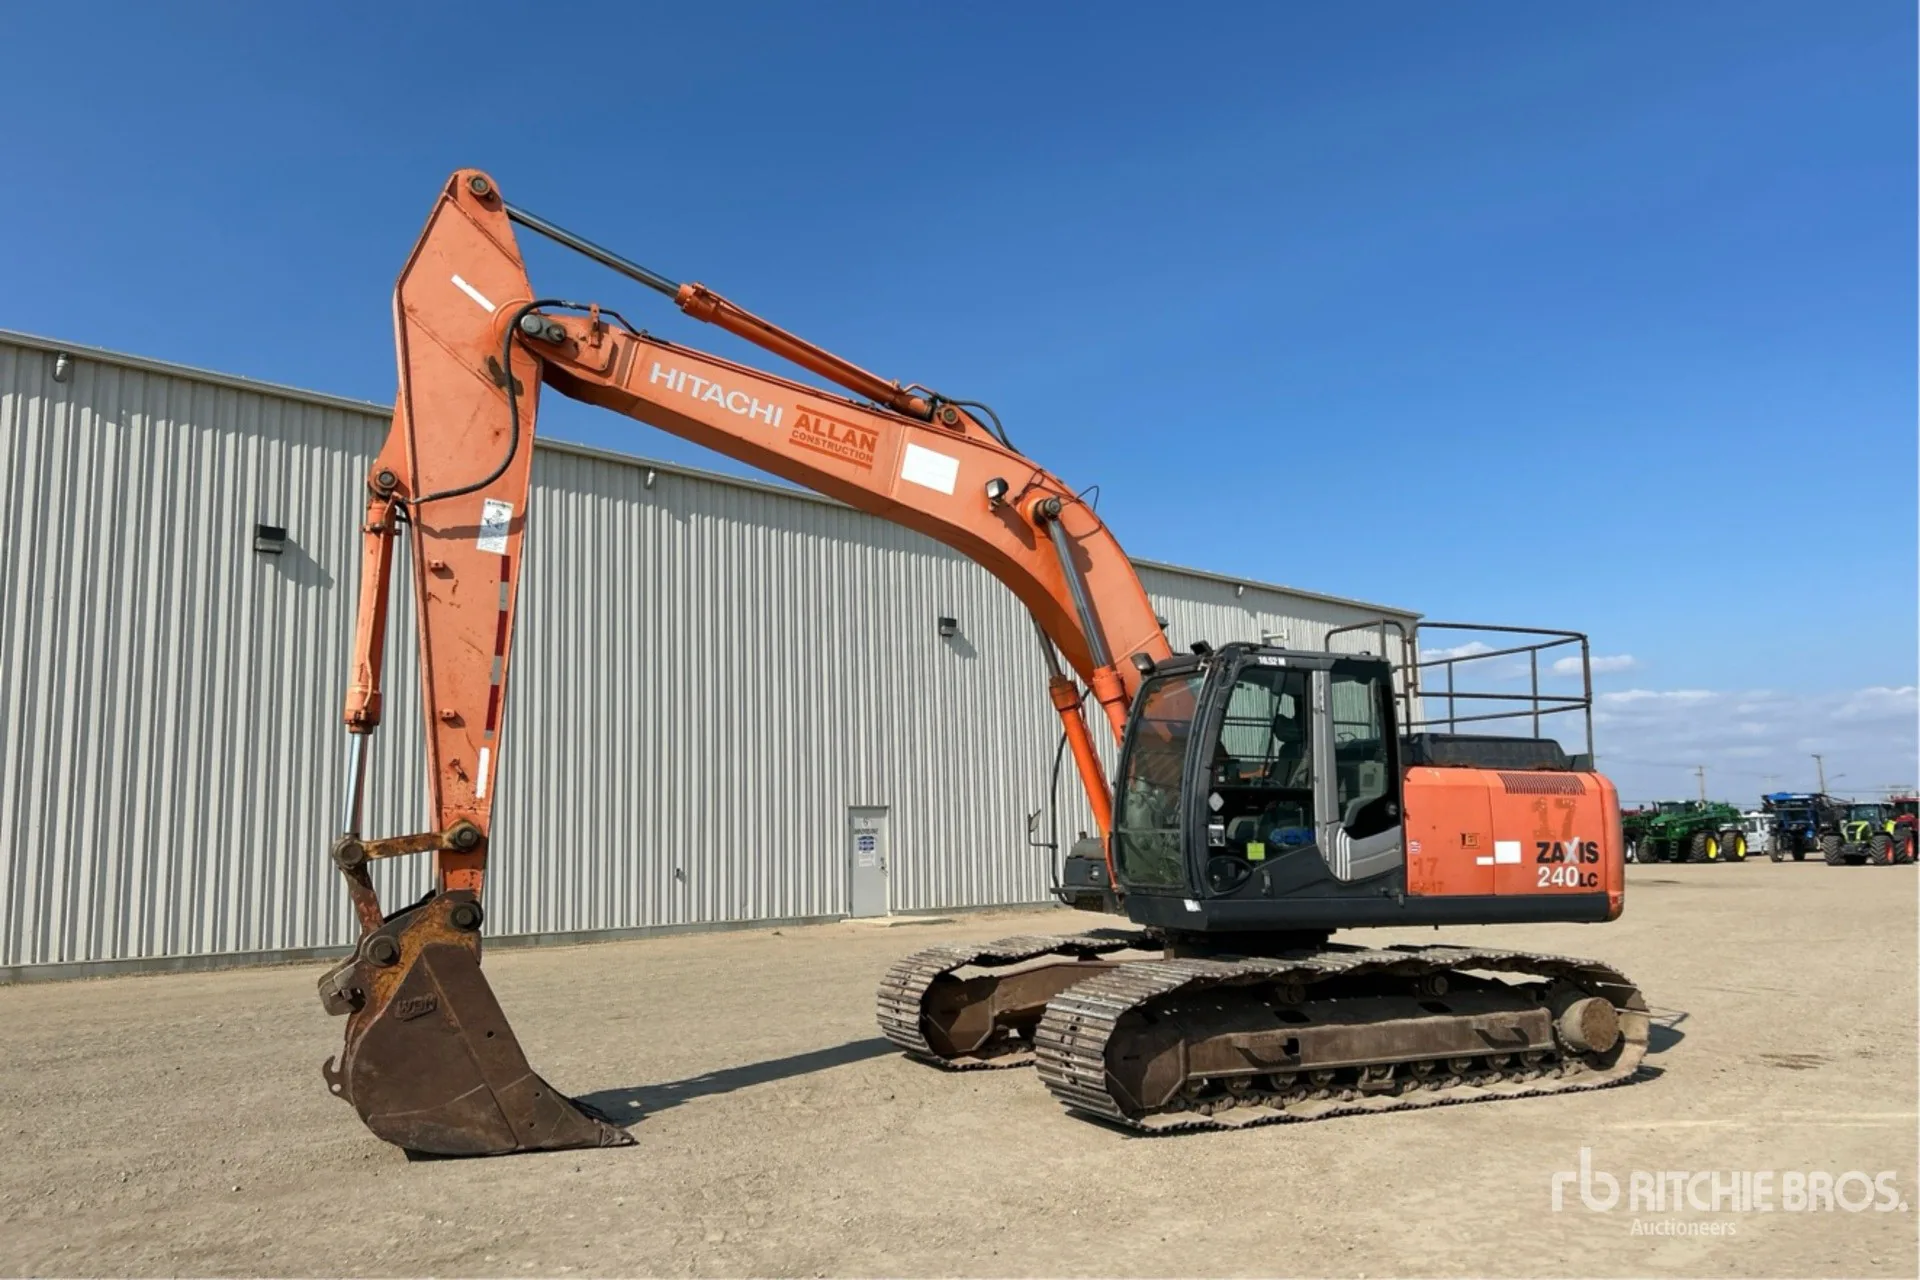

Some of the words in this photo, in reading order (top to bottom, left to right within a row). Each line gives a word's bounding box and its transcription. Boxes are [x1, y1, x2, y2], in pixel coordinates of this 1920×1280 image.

[649, 362, 783, 428] HITACHI
[791, 430, 873, 463] CONSTRUCTION
[793, 414, 878, 453] ALLAN
[1532, 797, 1577, 839] 17
[1536, 837, 1599, 864] ZAXIS
